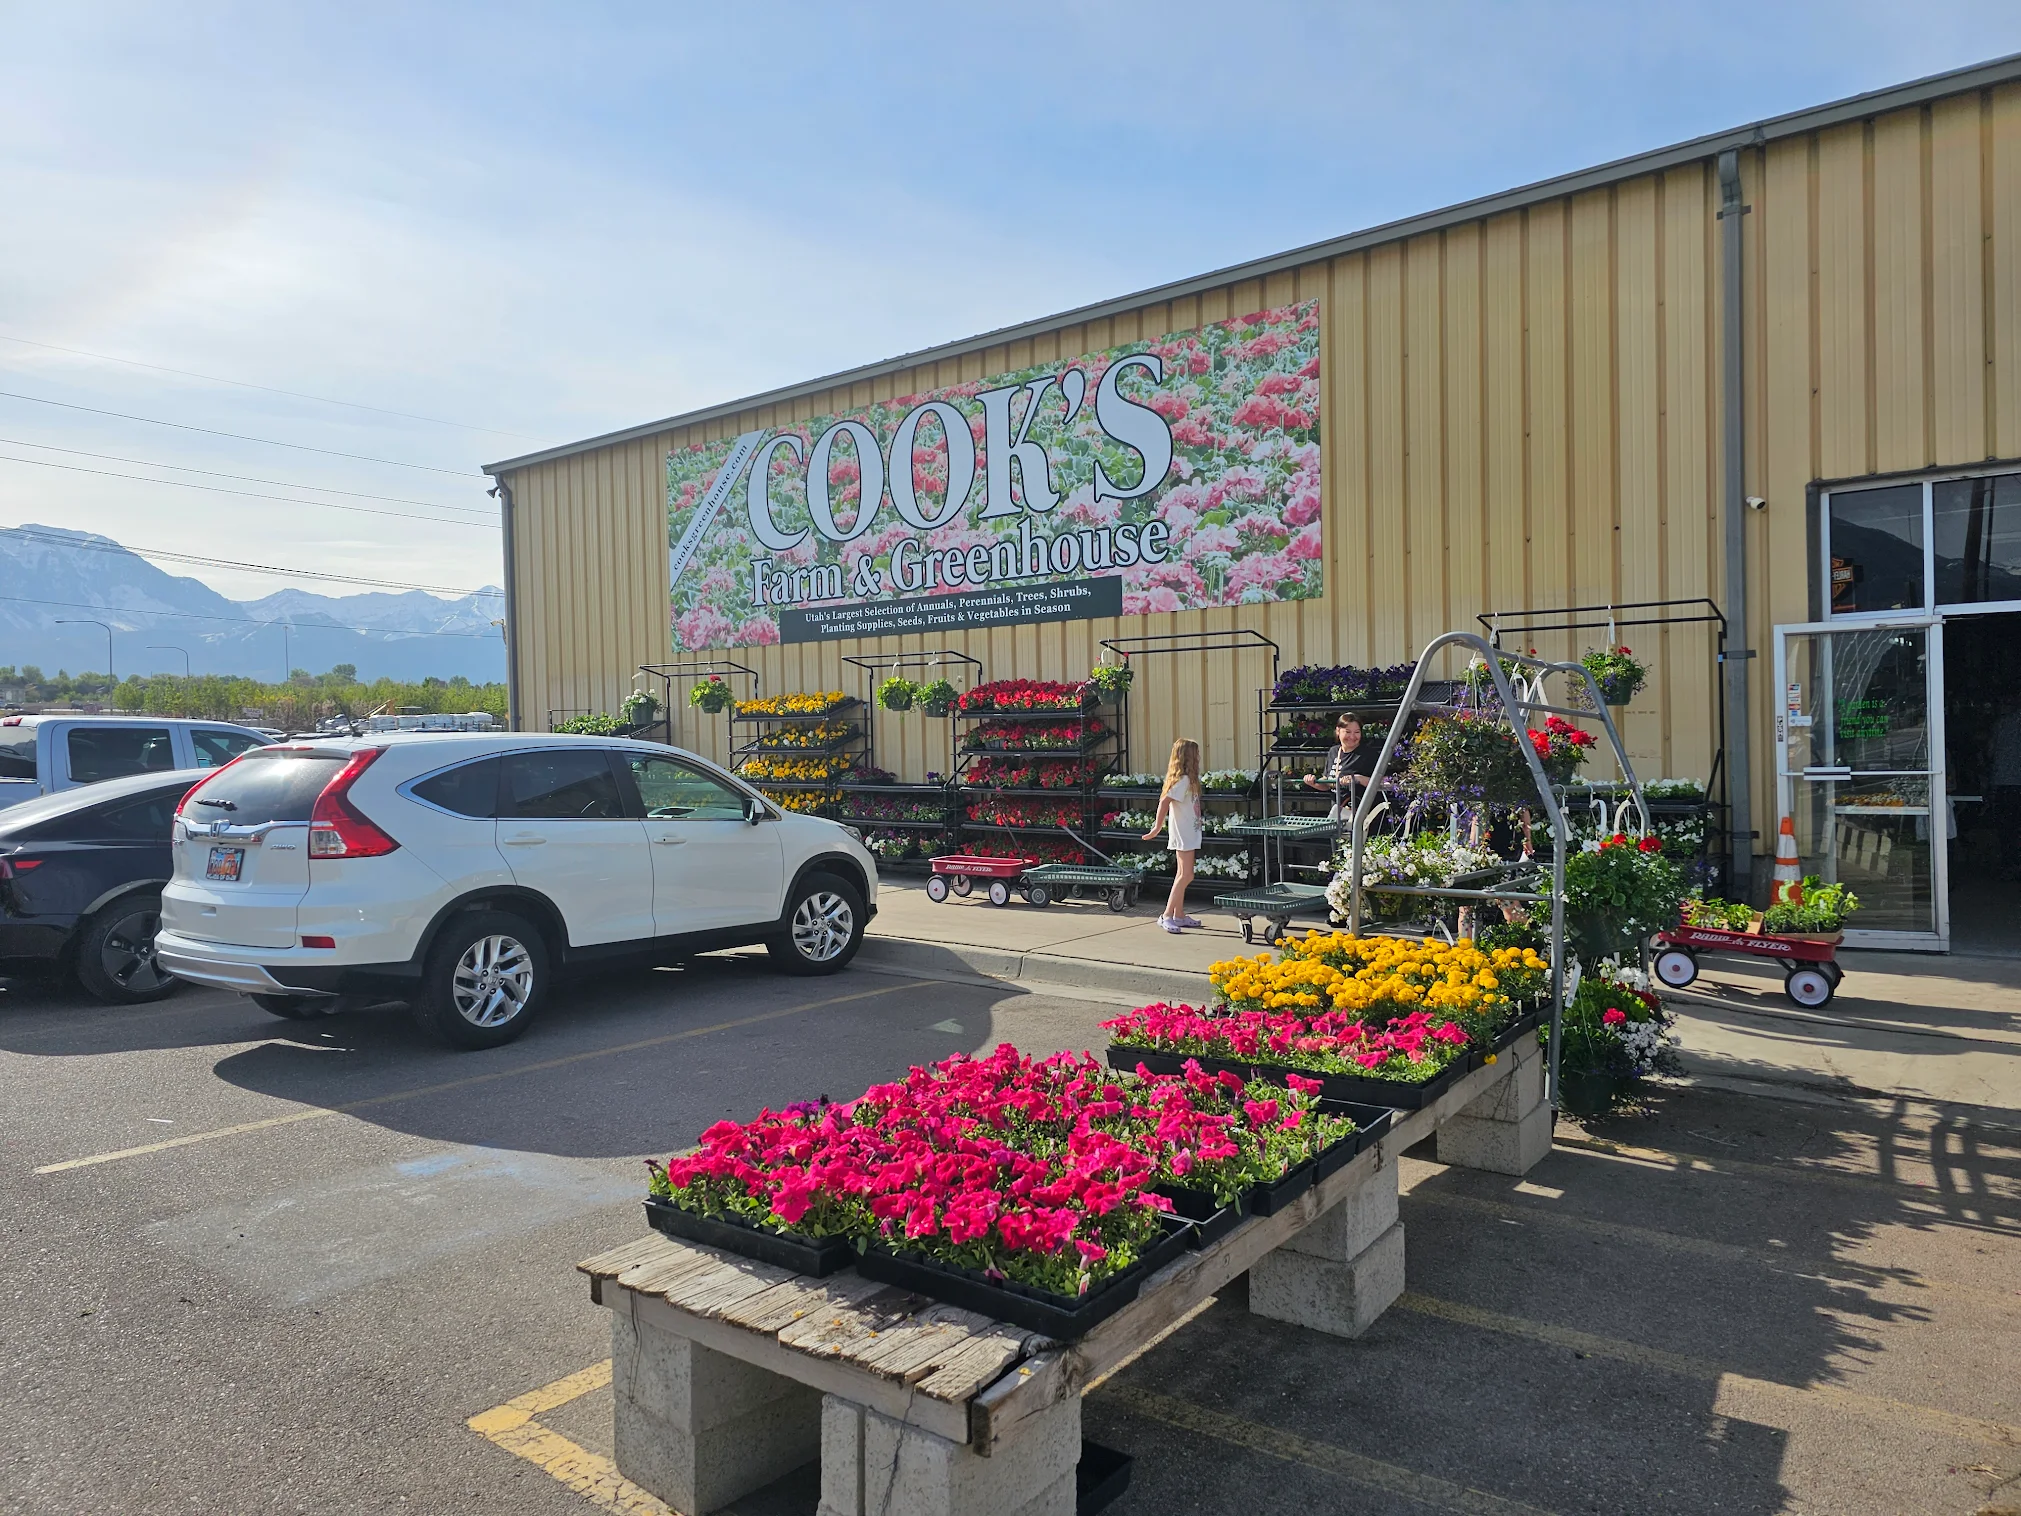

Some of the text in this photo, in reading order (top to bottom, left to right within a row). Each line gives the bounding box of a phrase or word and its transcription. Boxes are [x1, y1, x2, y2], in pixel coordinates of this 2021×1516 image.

[746, 353, 1173, 551] COOK'S
[673, 444, 748, 571] cooksgreenhouse.com
[750, 517, 1170, 607] Farm & Greenhouse
[805, 585, 1092, 622] Utah's Largest Selection of Annuals, Perennials, Trees, Shrubs,
[821, 603, 1071, 633] Planting Supplies, Seeds, Fruits & Vegetables in Season
[1840, 728, 1855, 738] visit
[1861, 716, 1875, 728] you
[1875, 715, 1889, 724] can
[1689, 931, 1792, 951] RADIO FLYER
